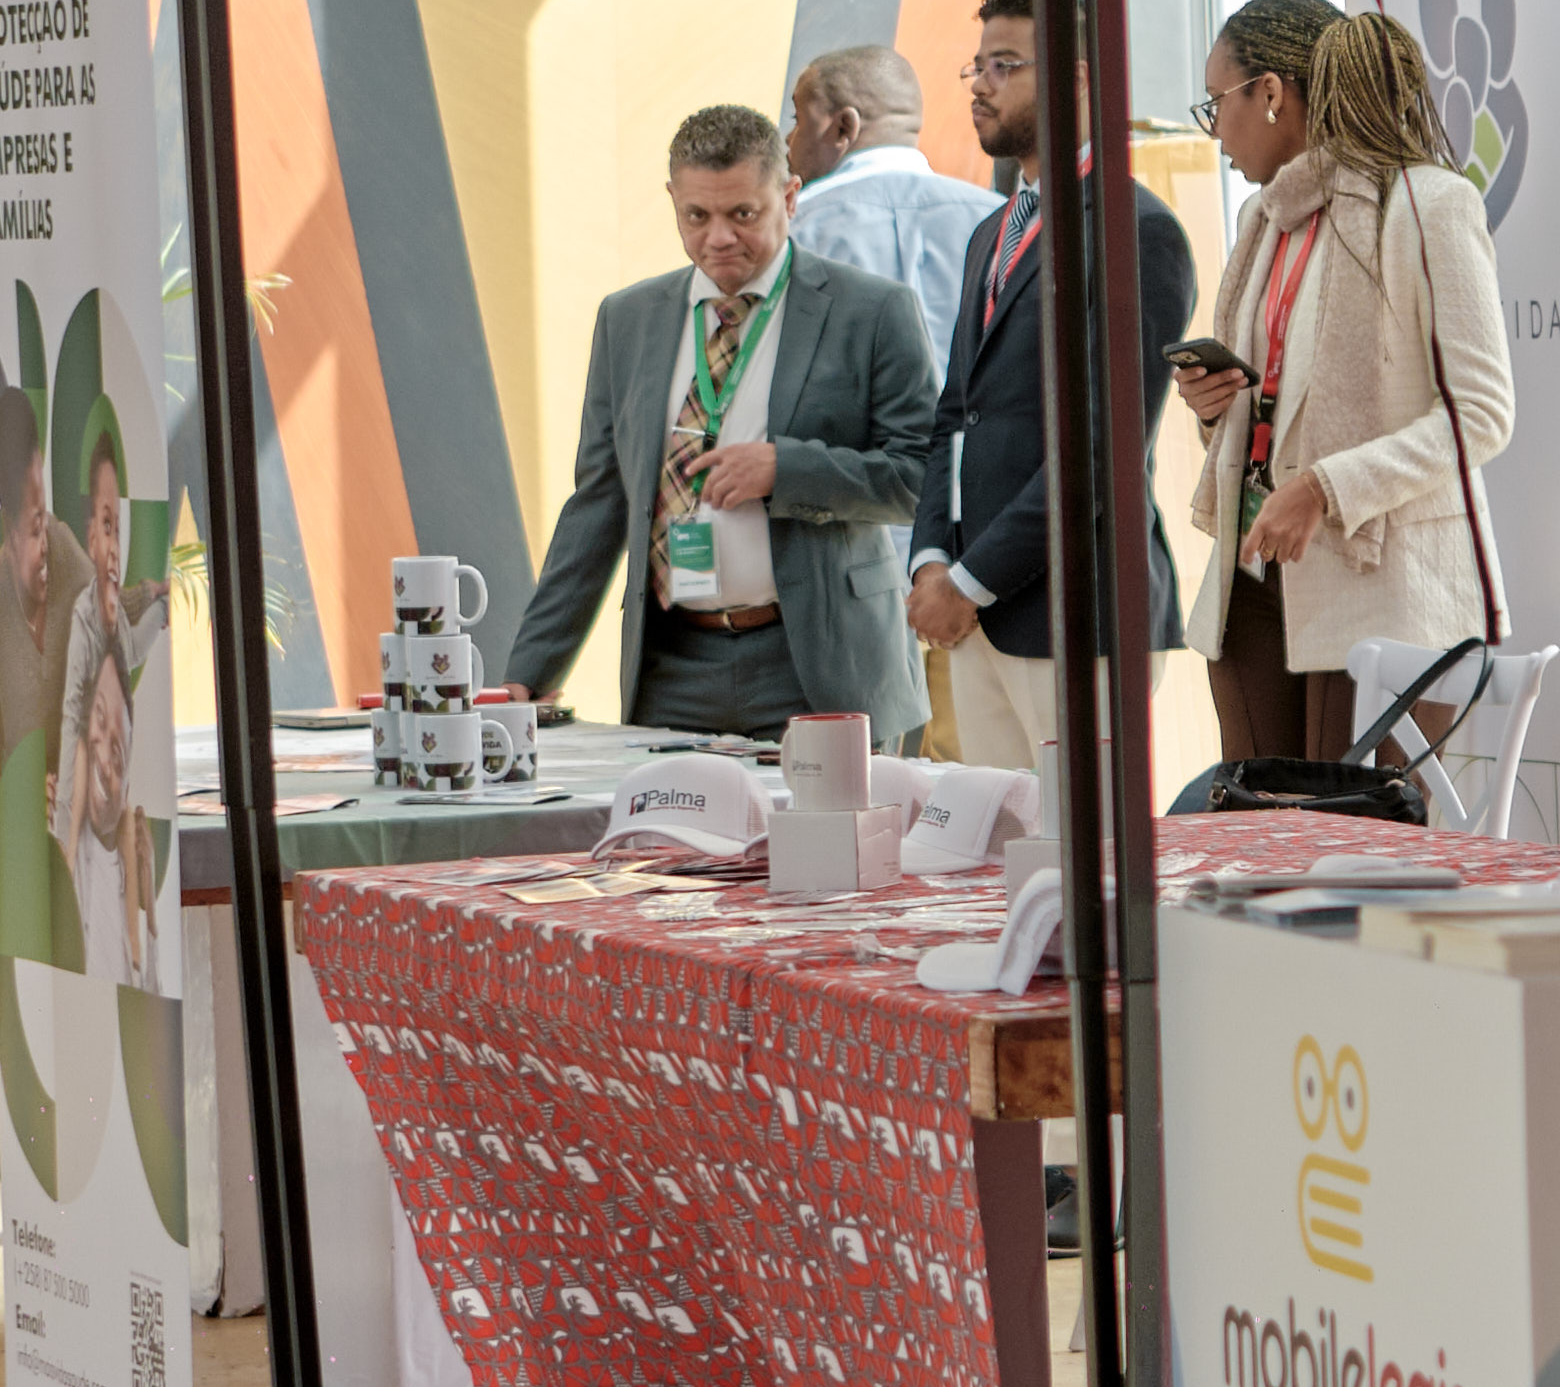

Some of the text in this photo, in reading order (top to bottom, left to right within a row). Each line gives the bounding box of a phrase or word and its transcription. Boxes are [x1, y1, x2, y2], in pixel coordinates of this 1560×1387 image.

[35, 65, 76, 108] PARA
[80, 62, 96, 106] AS
[63, 131, 74, 173] E
[647, 788, 706, 808] Palma
[11, 1218, 57, 1258] Telefone:
[15, 1303, 47, 1339] Email:
